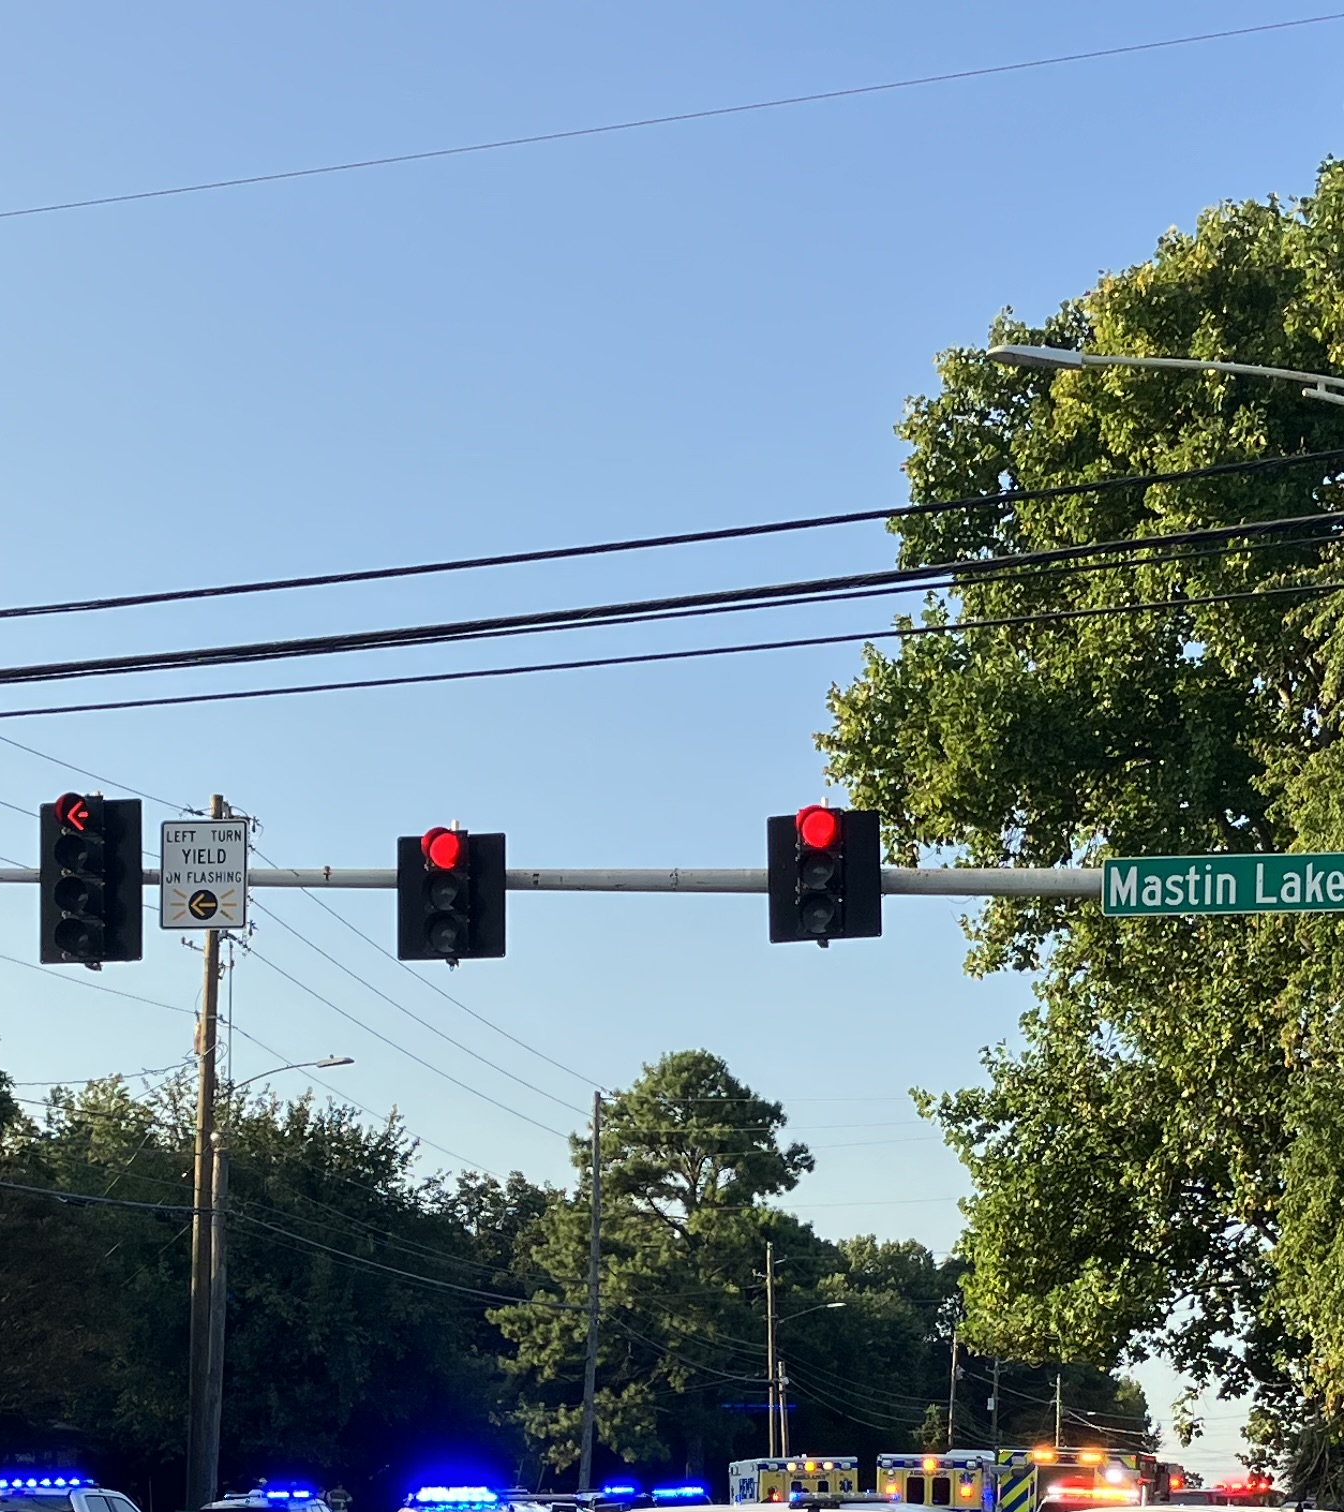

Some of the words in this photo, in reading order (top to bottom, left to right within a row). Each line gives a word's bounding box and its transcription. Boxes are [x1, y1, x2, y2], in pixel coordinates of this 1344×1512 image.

[166, 831, 196, 843] LEFT
[211, 830, 242, 842] TURN
[182, 849, 226, 864] YIELD
[166, 872, 181, 884] ON
[187, 872, 242, 883] FLASHING
[1109, 863, 1237, 907] Mastin
